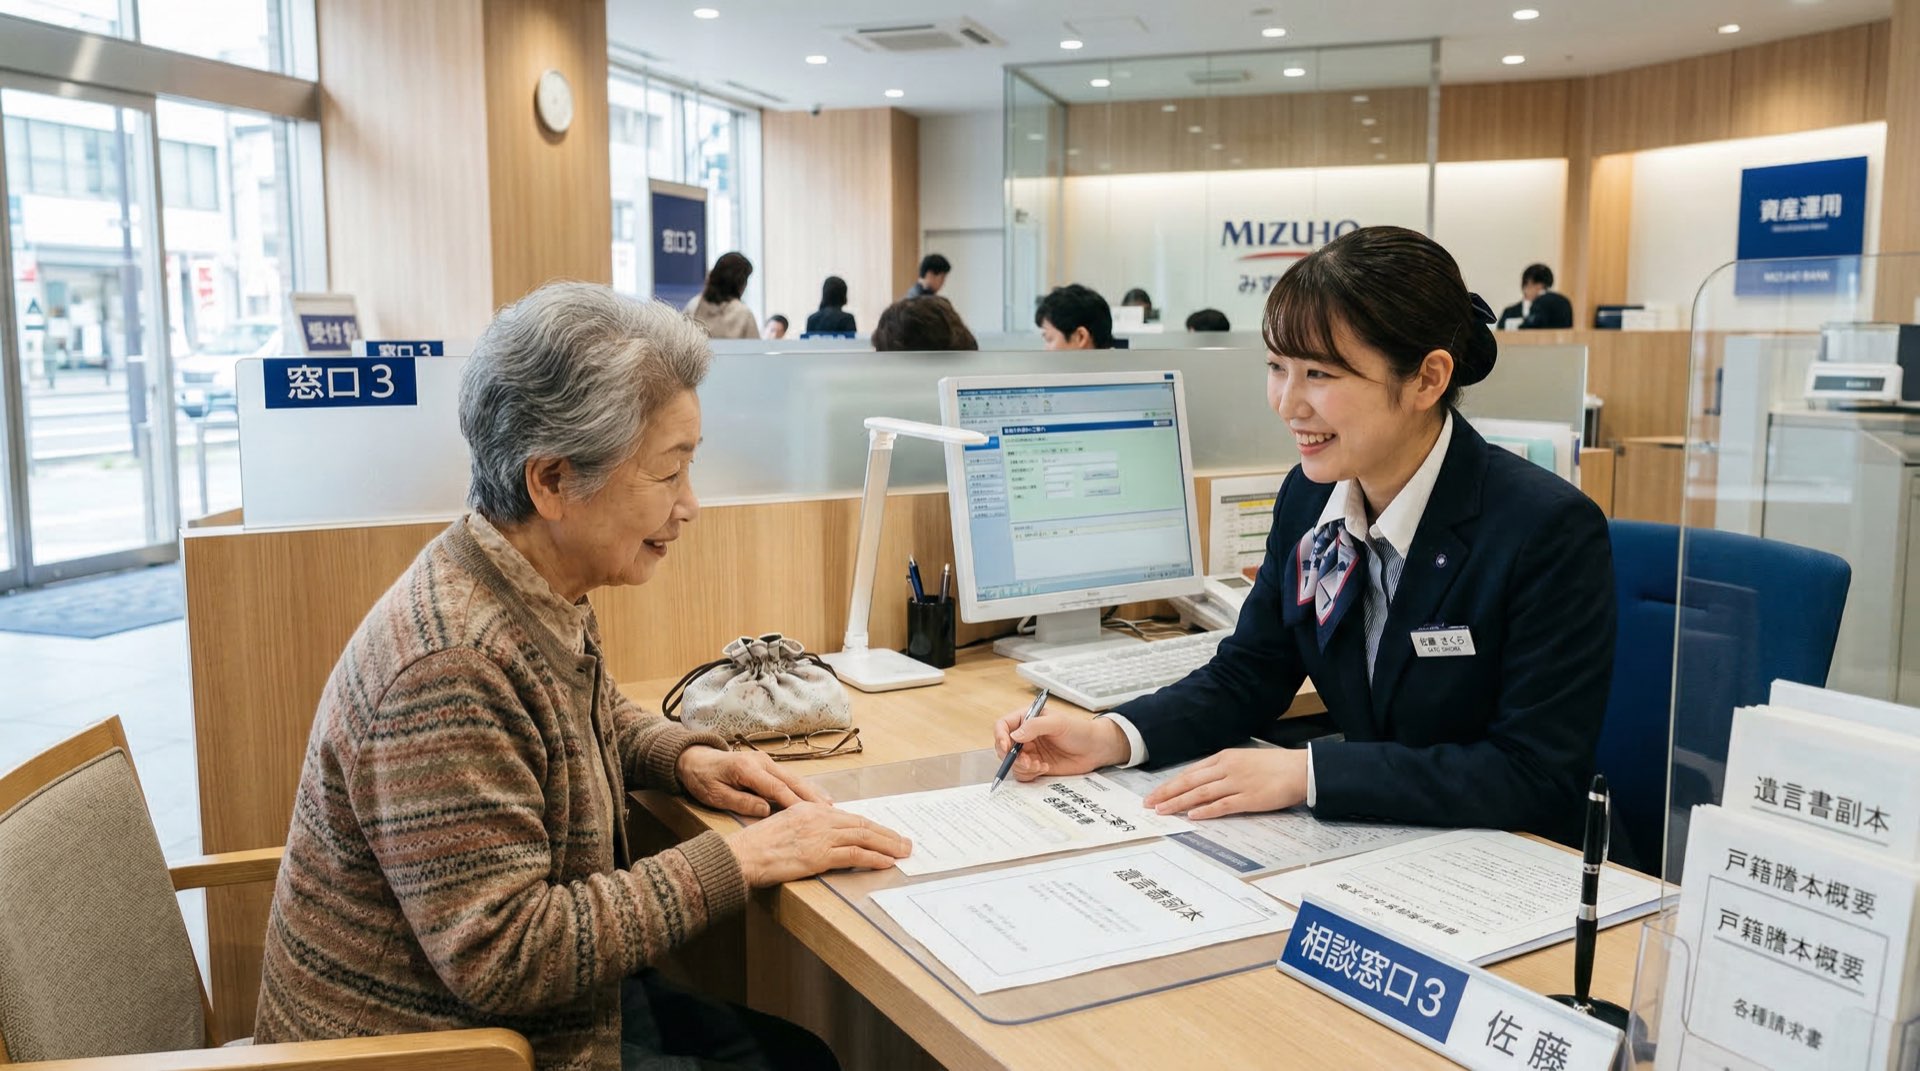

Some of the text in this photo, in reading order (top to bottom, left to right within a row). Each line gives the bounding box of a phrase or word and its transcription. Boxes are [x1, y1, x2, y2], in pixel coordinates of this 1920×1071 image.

[1760, 194, 1841, 223] 資産運用
[1754, 776, 1891, 834] 遺言書副本
[1725, 848, 1877, 920] 戸籍謄本概要
[1301, 921, 1446, 1017] 相談窓口3
[1718, 908, 1865, 985] 戸籍謄本概要
